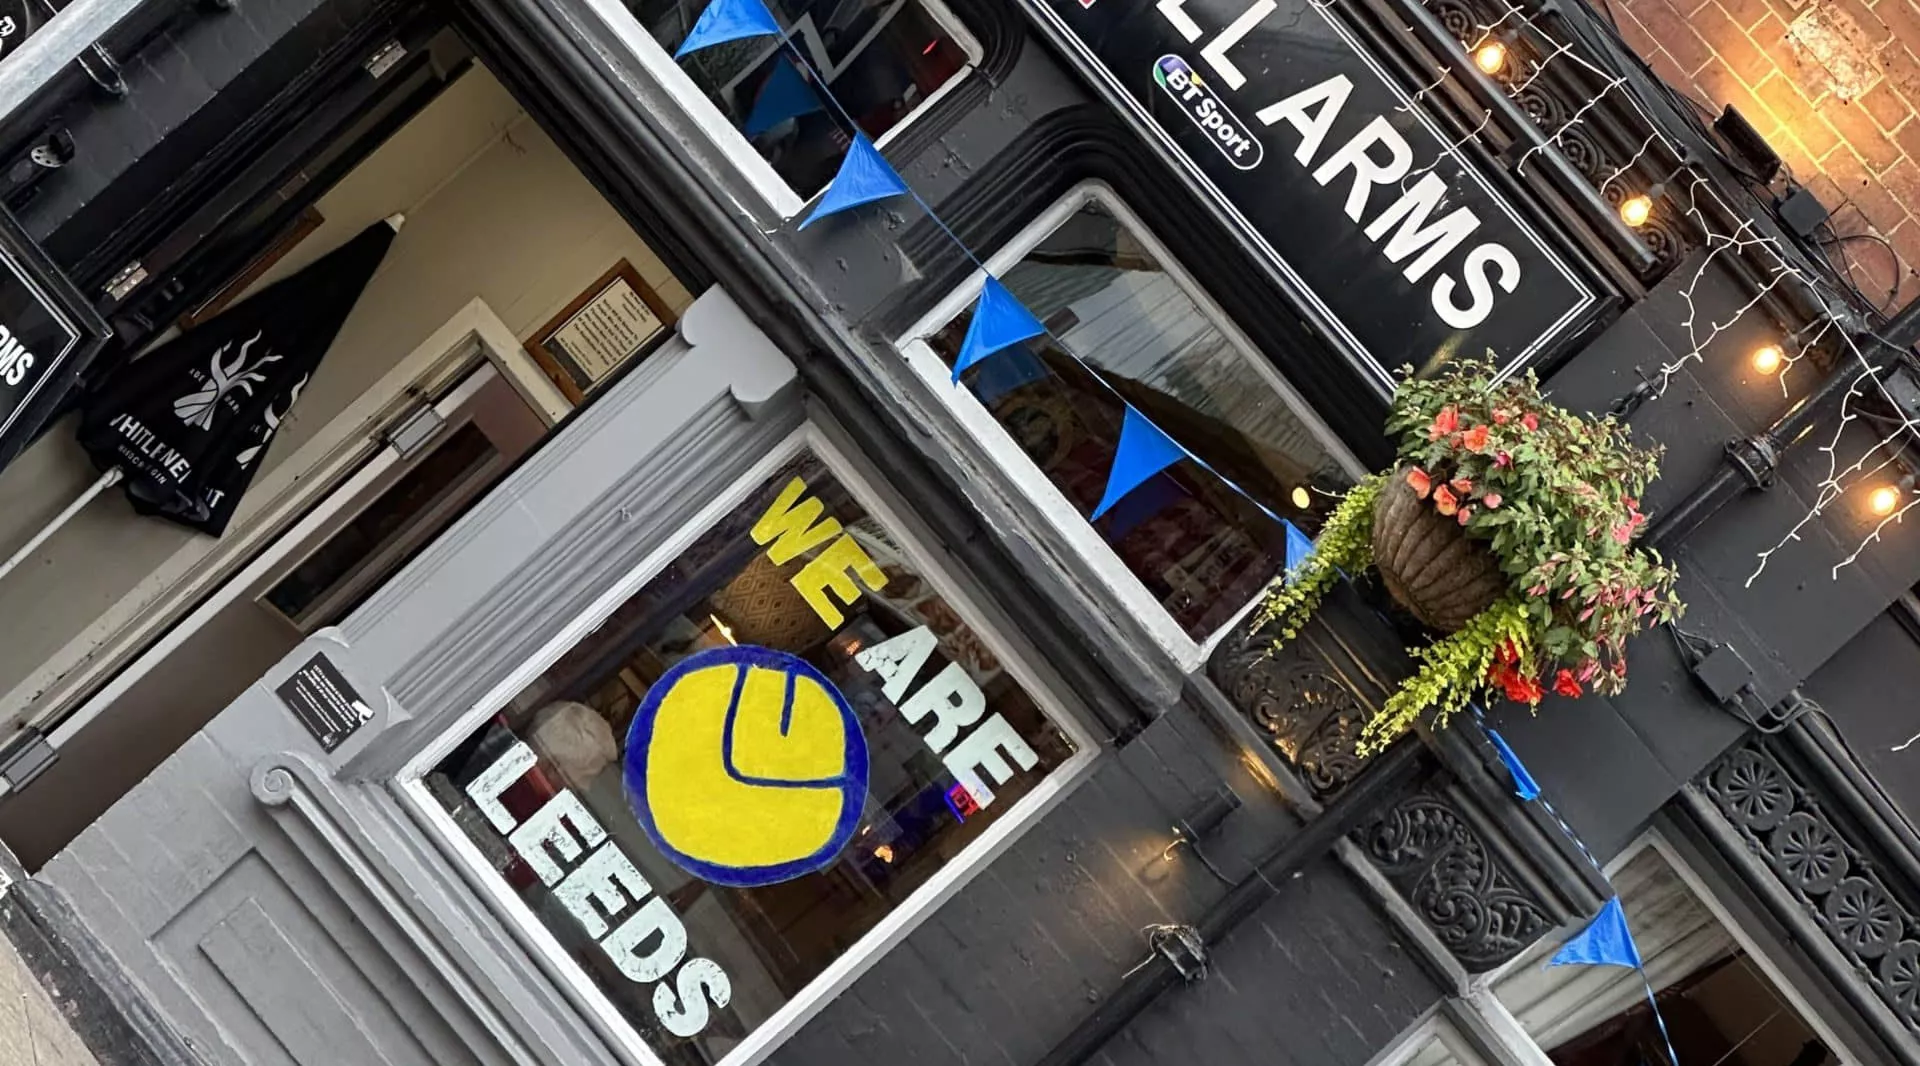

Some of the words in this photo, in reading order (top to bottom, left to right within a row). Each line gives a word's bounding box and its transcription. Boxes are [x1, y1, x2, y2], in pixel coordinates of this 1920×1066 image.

[1166, 68, 1204, 101] BT
[1195, 98, 1251, 157] Sport
[1256, 75, 1521, 329] ARMS
[750, 476, 888, 630] WE
[854, 625, 1039, 811] ARE
[465, 741, 732, 1038] LEEDS
